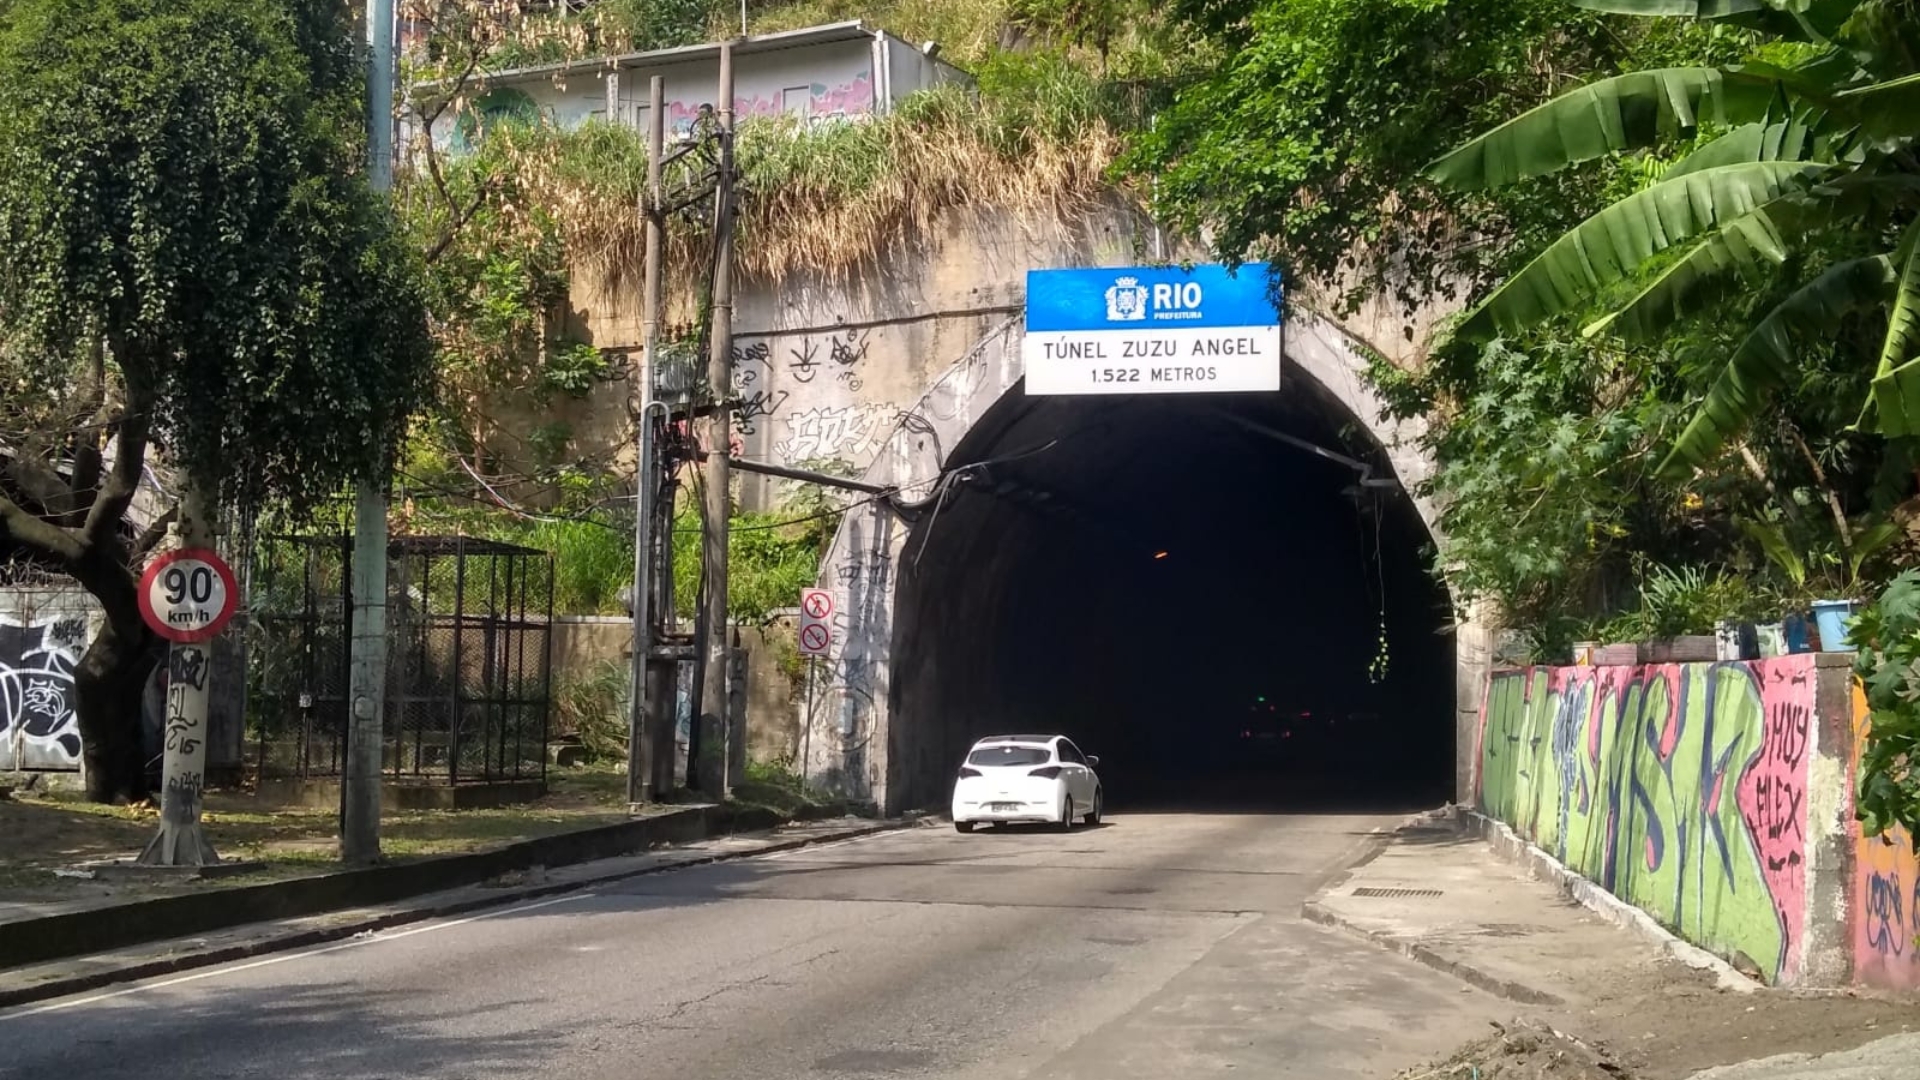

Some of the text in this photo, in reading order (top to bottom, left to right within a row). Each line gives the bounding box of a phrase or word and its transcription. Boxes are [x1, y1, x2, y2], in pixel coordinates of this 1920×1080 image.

[1154, 282, 1202, 309] RIO
[1154, 311, 1203, 320] PREFEITURA
[1043, 335, 1261, 359] TÚNEL ZUZU ANGEL
[1092, 367, 1217, 383] 1.522 METROS
[165, 567, 212, 605] 90
[168, 609, 210, 623] km/h
